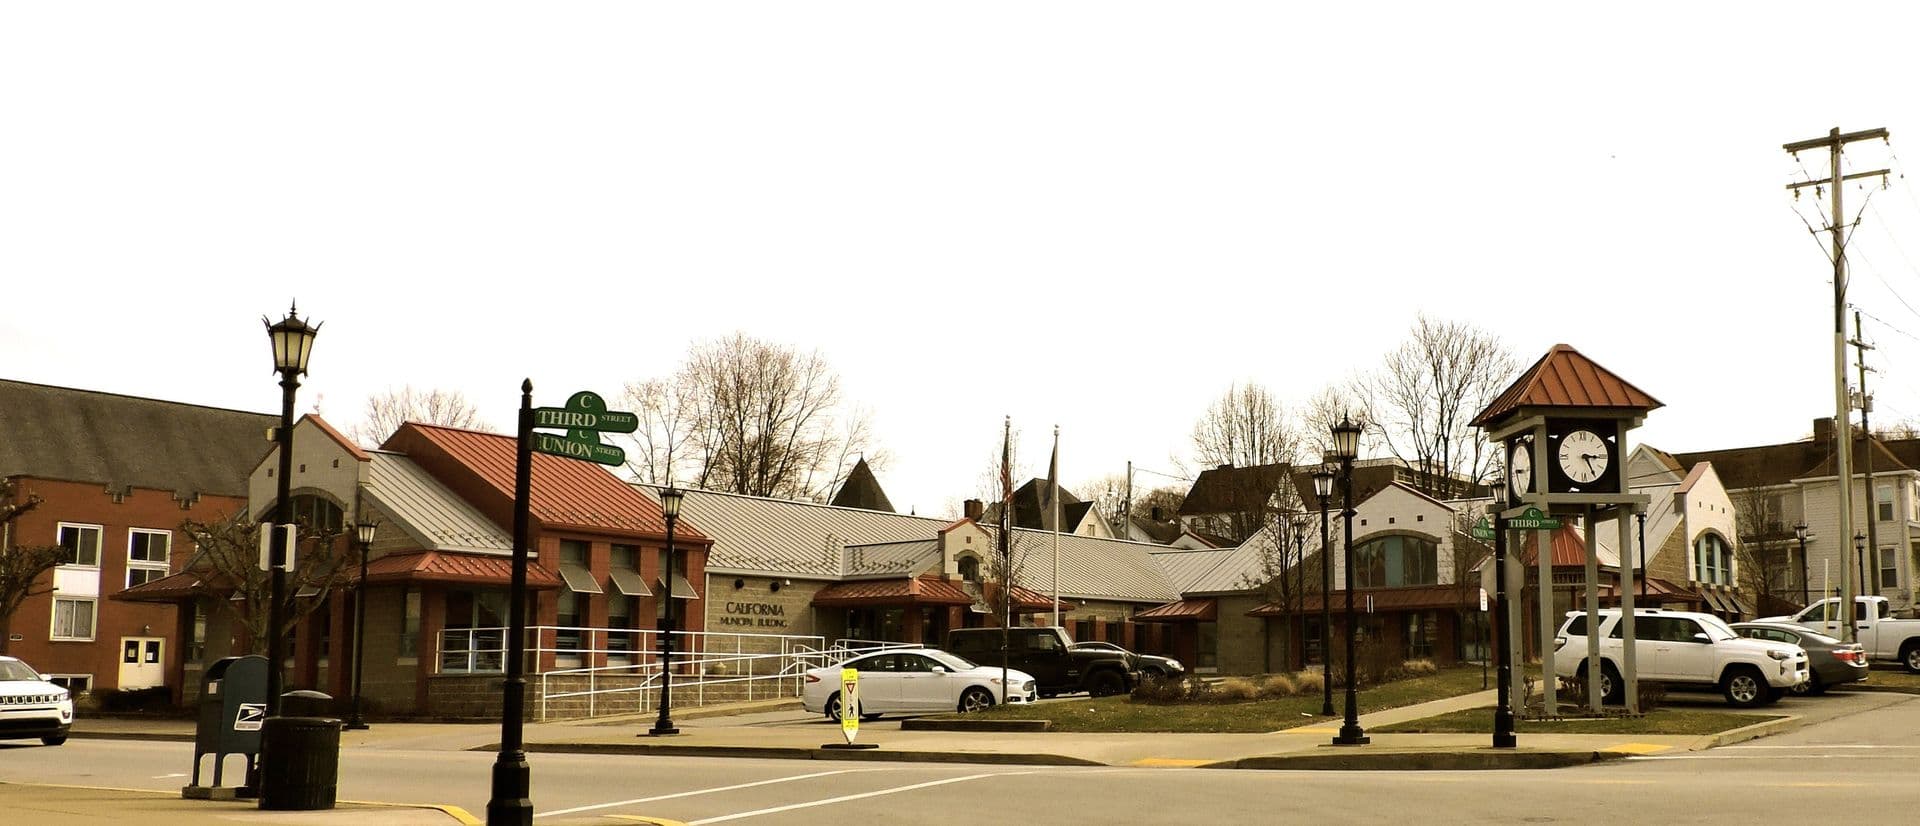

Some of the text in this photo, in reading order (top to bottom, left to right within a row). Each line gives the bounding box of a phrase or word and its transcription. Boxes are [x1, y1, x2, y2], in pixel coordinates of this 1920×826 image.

[580, 395, 592, 409] C
[538, 410, 633, 427] THIRD STREET
[542, 436, 621, 458] UNION STREET
[1529, 509, 1537, 518] C
[1508, 519, 1540, 528] THIRD
[726, 601, 785, 616] CALIFORNIA
